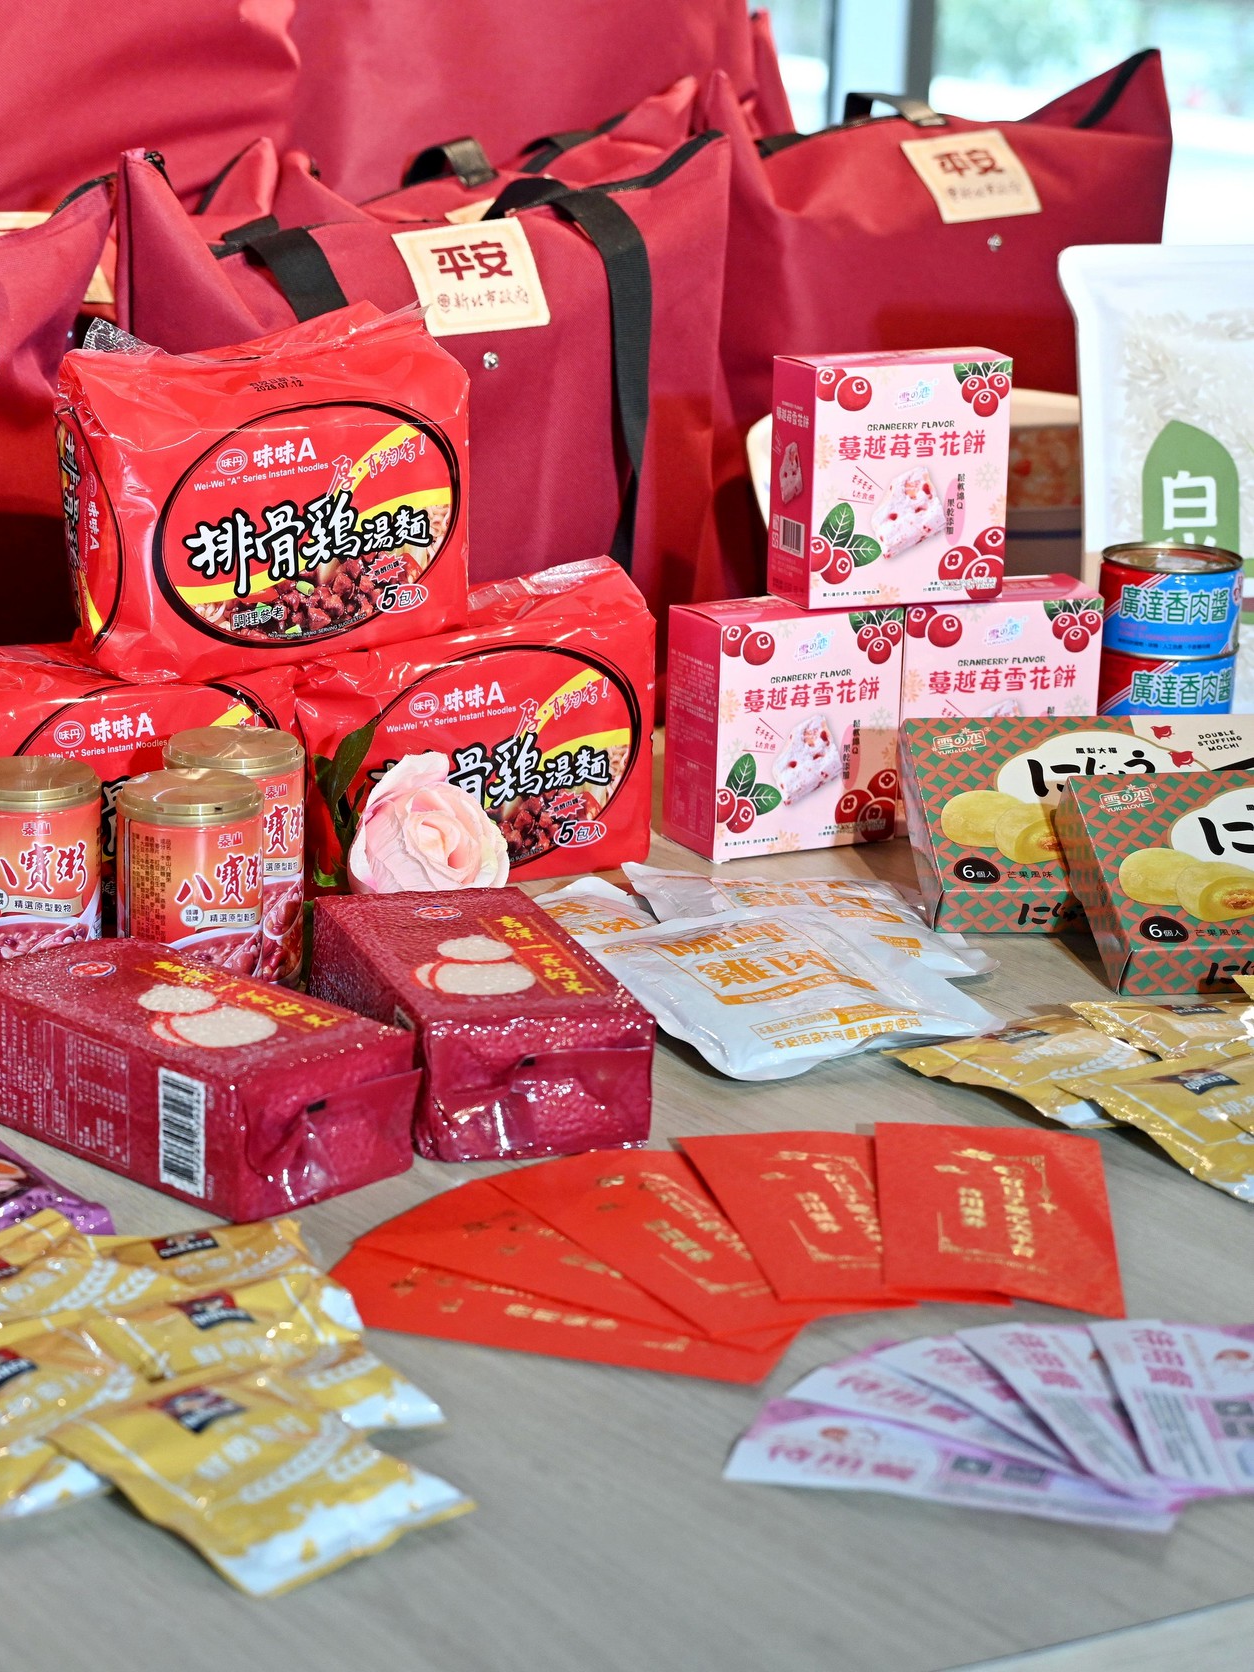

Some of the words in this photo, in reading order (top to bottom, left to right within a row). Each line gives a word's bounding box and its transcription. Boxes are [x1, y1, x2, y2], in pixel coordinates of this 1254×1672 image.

[934, 150, 1003, 177] 平安
[430, 241, 513, 281] 平安
[454, 285, 530, 311] 新北市政府
[867, 421, 918, 432] CRANBERRY
[921, 420, 955, 430] FLAVOR
[253, 437, 317, 468] 味味A
[221, 455, 243, 469] 味丹
[194, 478, 226, 492] Wei-Wei
[227, 476, 240, 486] "A"
[243, 472, 267, 484] Series
[269, 467, 295, 479] Instant
[298, 461, 329, 474] Noodles
[382, 585, 424, 611] 5包入
[1119, 584, 1230, 623] 廣達香肉醬
[232, 604, 285, 629] 調理參考
[958, 657, 1009, 667] CRANBERRY
[1012, 655, 1046, 665] FLAVOR
[770, 671, 817, 684] CRANBERRY
[820, 669, 852, 679] FLAVOR
[444, 681, 505, 711] 味味A
[1129, 670, 1233, 706] 廣達香肉醬
[413, 700, 435, 713] 味丹
[90, 712, 156, 743] 味味A
[386, 722, 418, 734] Wei-Wei
[419, 719, 431, 729] "A"
[434, 714, 458, 726] Series
[459, 710, 484, 721] Instant
[486, 705, 516, 718] Noodles
[59, 728, 81, 742] 味丹
[1197, 735, 1242, 747] STUFFING
[1198, 730, 1235, 741] DOUBLE
[81, 748, 105, 757] Series
[107, 743, 133, 753] Instant
[136, 739, 168, 749] Noodles
[938, 746, 977, 756] YUKI&LOVE
[1208, 743, 1240, 752] MOCHI
[265, 783, 287, 800] 泰山
[1106, 803, 1146, 813] YUKI&LOVE
[22, 821, 51, 837] 泰山
[557, 821, 604, 846] 5包入
[218, 832, 243, 848] 泰山
[961, 864, 996, 879] 6個入
[14, 898, 72, 914] 精選原型穀物
[1148, 924, 1184, 938] 6個入
[697, 949, 841, 988] 雞肉
[1183, 1073, 1231, 1090] QUAKER
